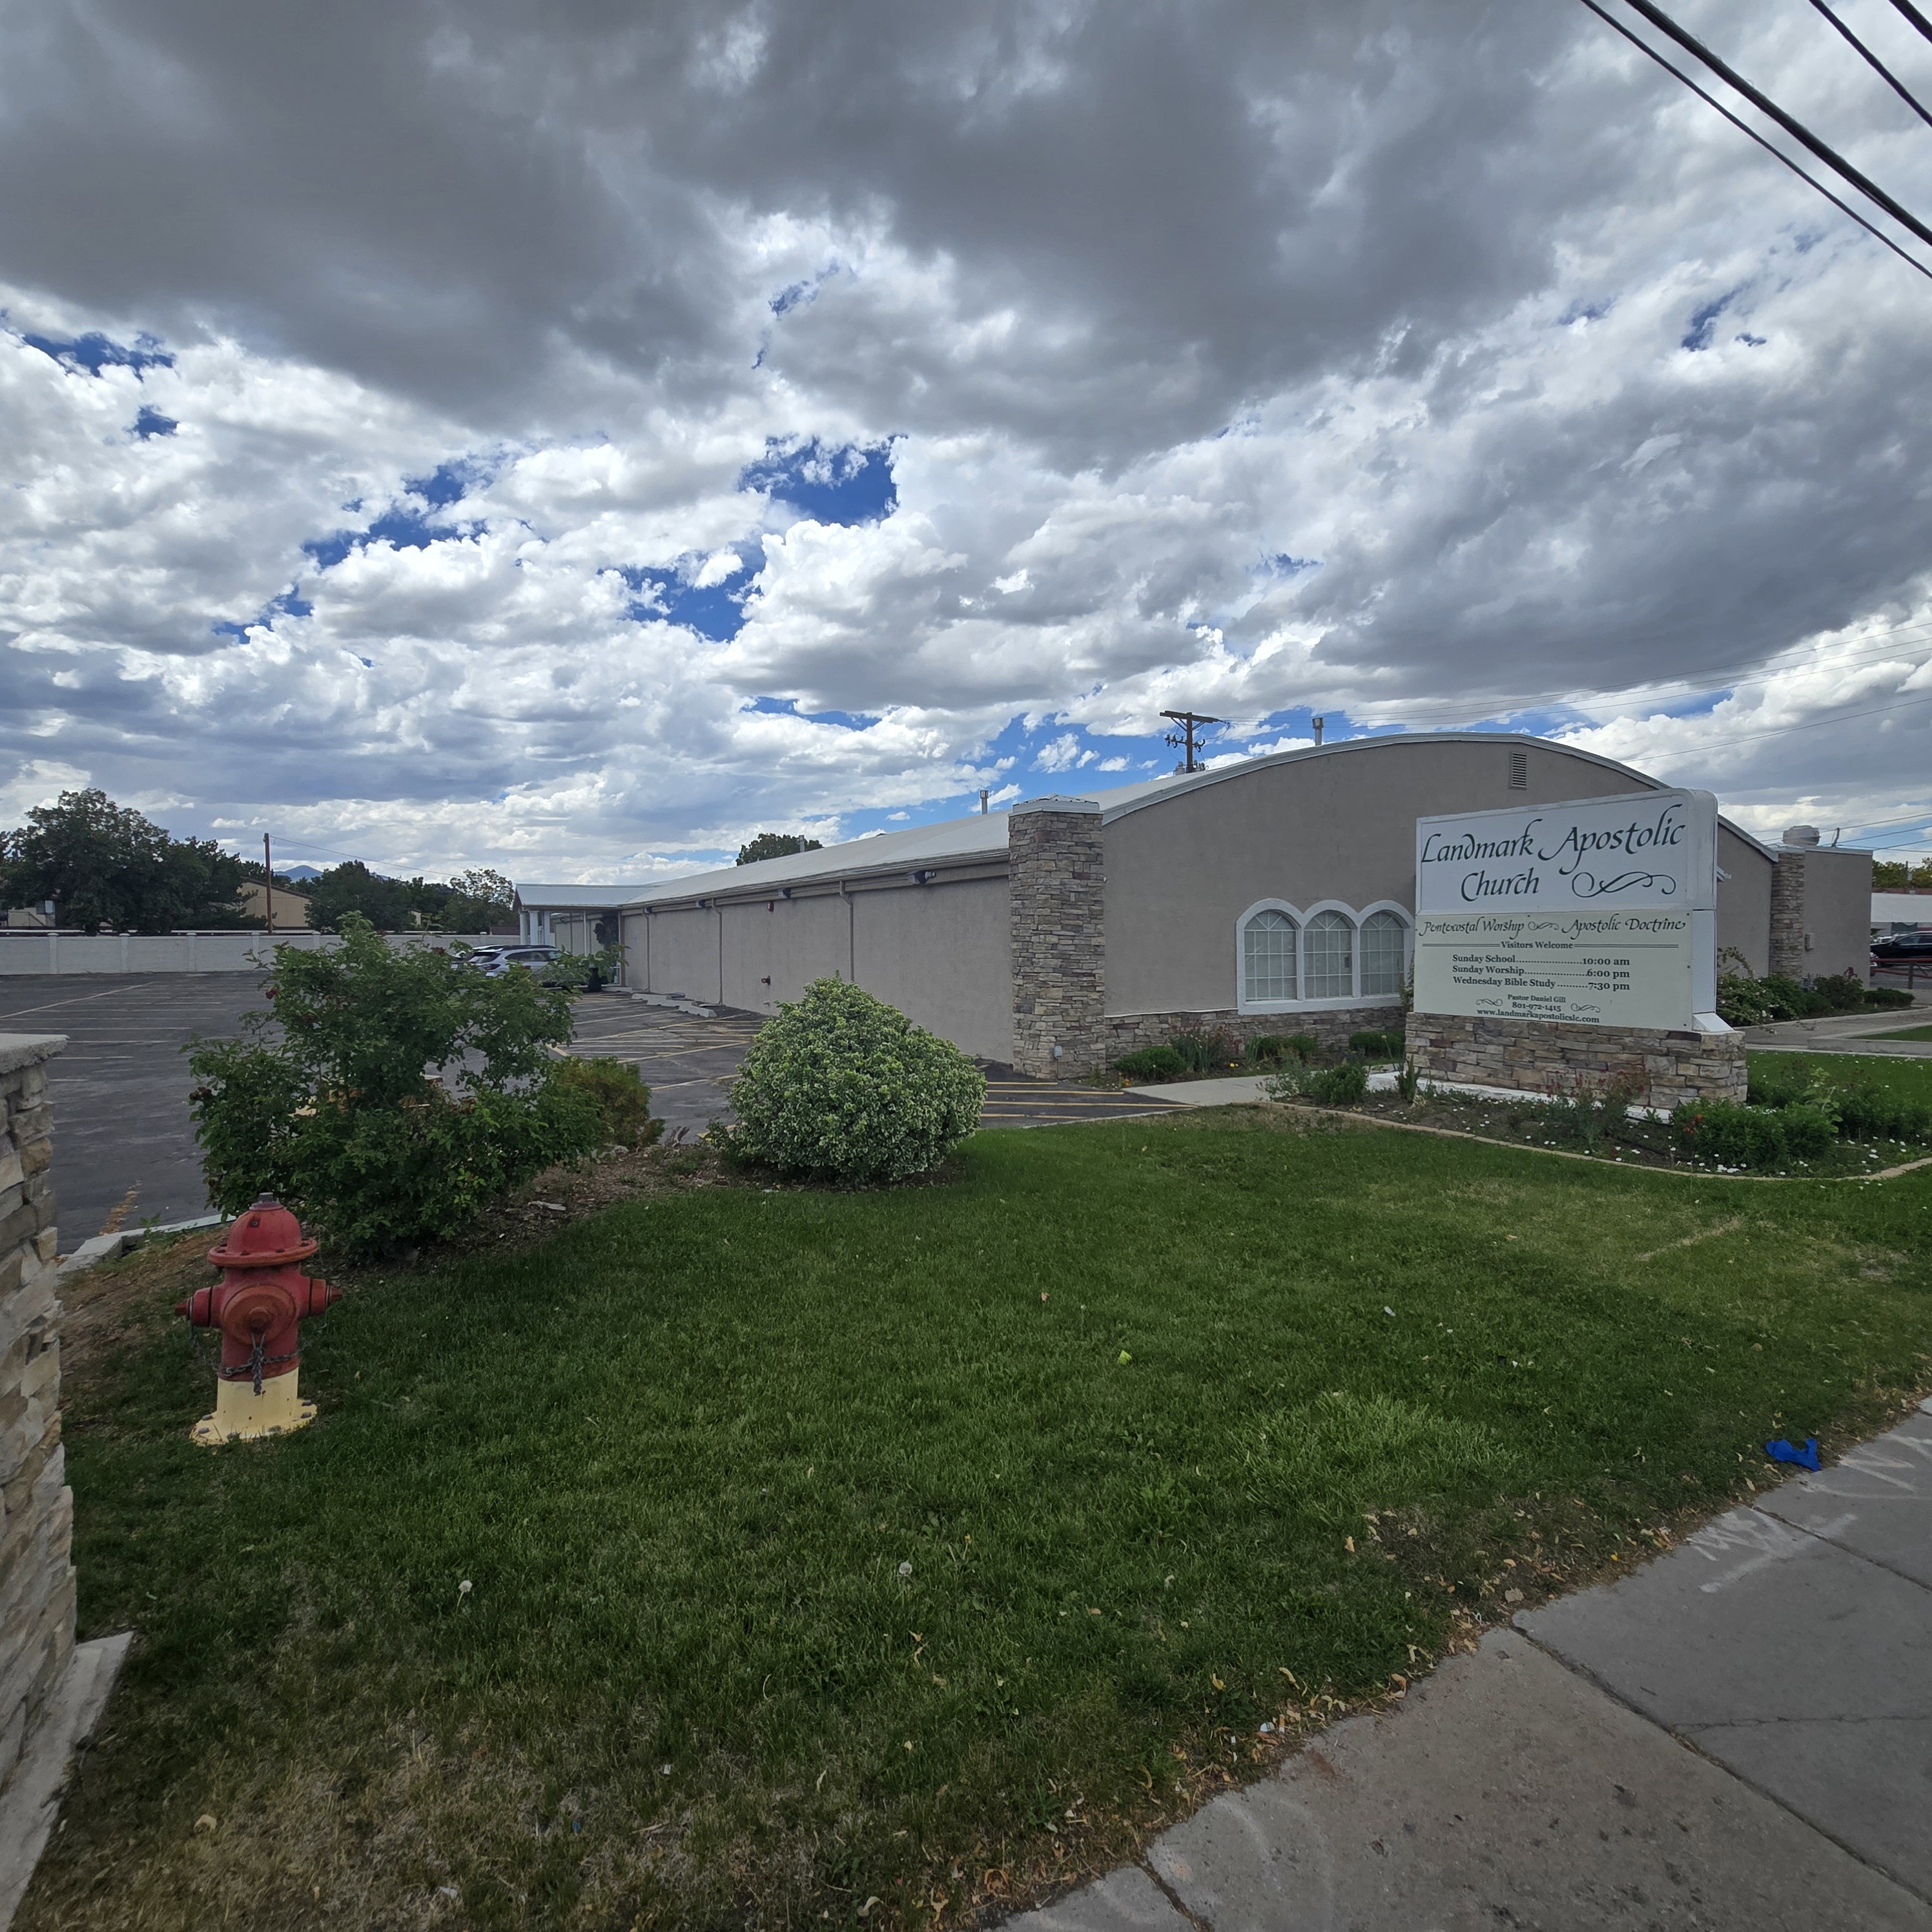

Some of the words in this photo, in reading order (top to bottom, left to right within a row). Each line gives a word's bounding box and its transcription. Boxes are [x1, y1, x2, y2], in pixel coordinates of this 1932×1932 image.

[1421, 818, 1543, 863] Landmark
[1537, 804, 1686, 875] Apostolic
[1461, 867, 1539, 902] Church
[1419, 916, 1485, 936] Pentecostal
[1561, 913, 1621, 940] Apostolic
[1625, 918, 1685, 932] Doctrine
[1452, 954, 1484, 963] Sunday
[1452, 965, 1484, 974] Sunday
[1613, 971, 1630, 979] pm
[1453, 976, 1503, 987] Wednesday
[1505, 978, 1528, 986] Bible
[1613, 983, 1630, 991] pm
[1512, 1002, 1561, 1012] 801-972-1415
[1477, 1009, 1600, 1023] www.landmarkapostolicslc.com
